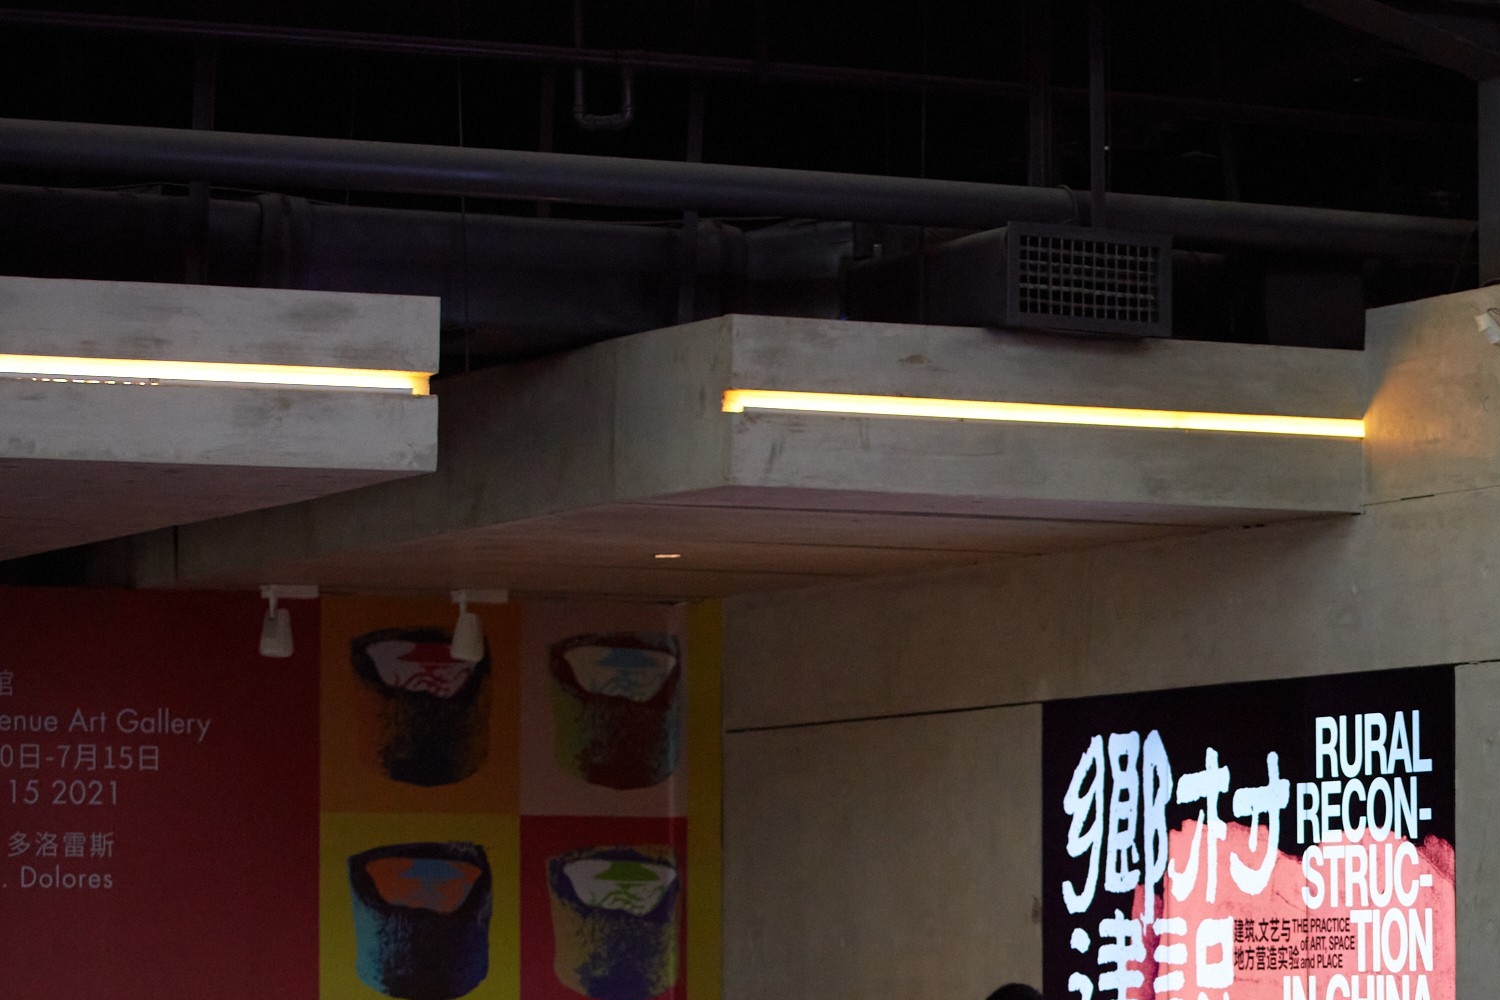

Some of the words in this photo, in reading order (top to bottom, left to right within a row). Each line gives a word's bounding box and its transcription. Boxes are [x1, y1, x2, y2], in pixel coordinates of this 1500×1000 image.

[68, 707, 108, 733] Art
[116, 707, 212, 743] Gallery
[1314, 709, 1433, 779] RURAL
[9, 779, 39, 805] 15
[52, 779, 118, 806] 2021
[1296, 776, 1433, 845] RECON-
[8, 831, 115, 858] 多洛雷斯
[20, 864, 114, 889] Dolores
[1301, 841, 1433, 910] STRUC-
[1233, 918, 1291, 943] 建筑、文艺与
[1292, 918, 1309, 934] THE
[1310, 917, 1350, 933] PRACTICE
[1300, 937, 1309, 951] of
[1309, 936, 1328, 952] ART,
[1329, 935, 1356, 951] SPACE
[1350, 907, 1434, 973] TION
[1233, 945, 1300, 971] 地方营造实验
[1300, 955, 1315, 969] and
[1316, 954, 1344, 969] PLACE
